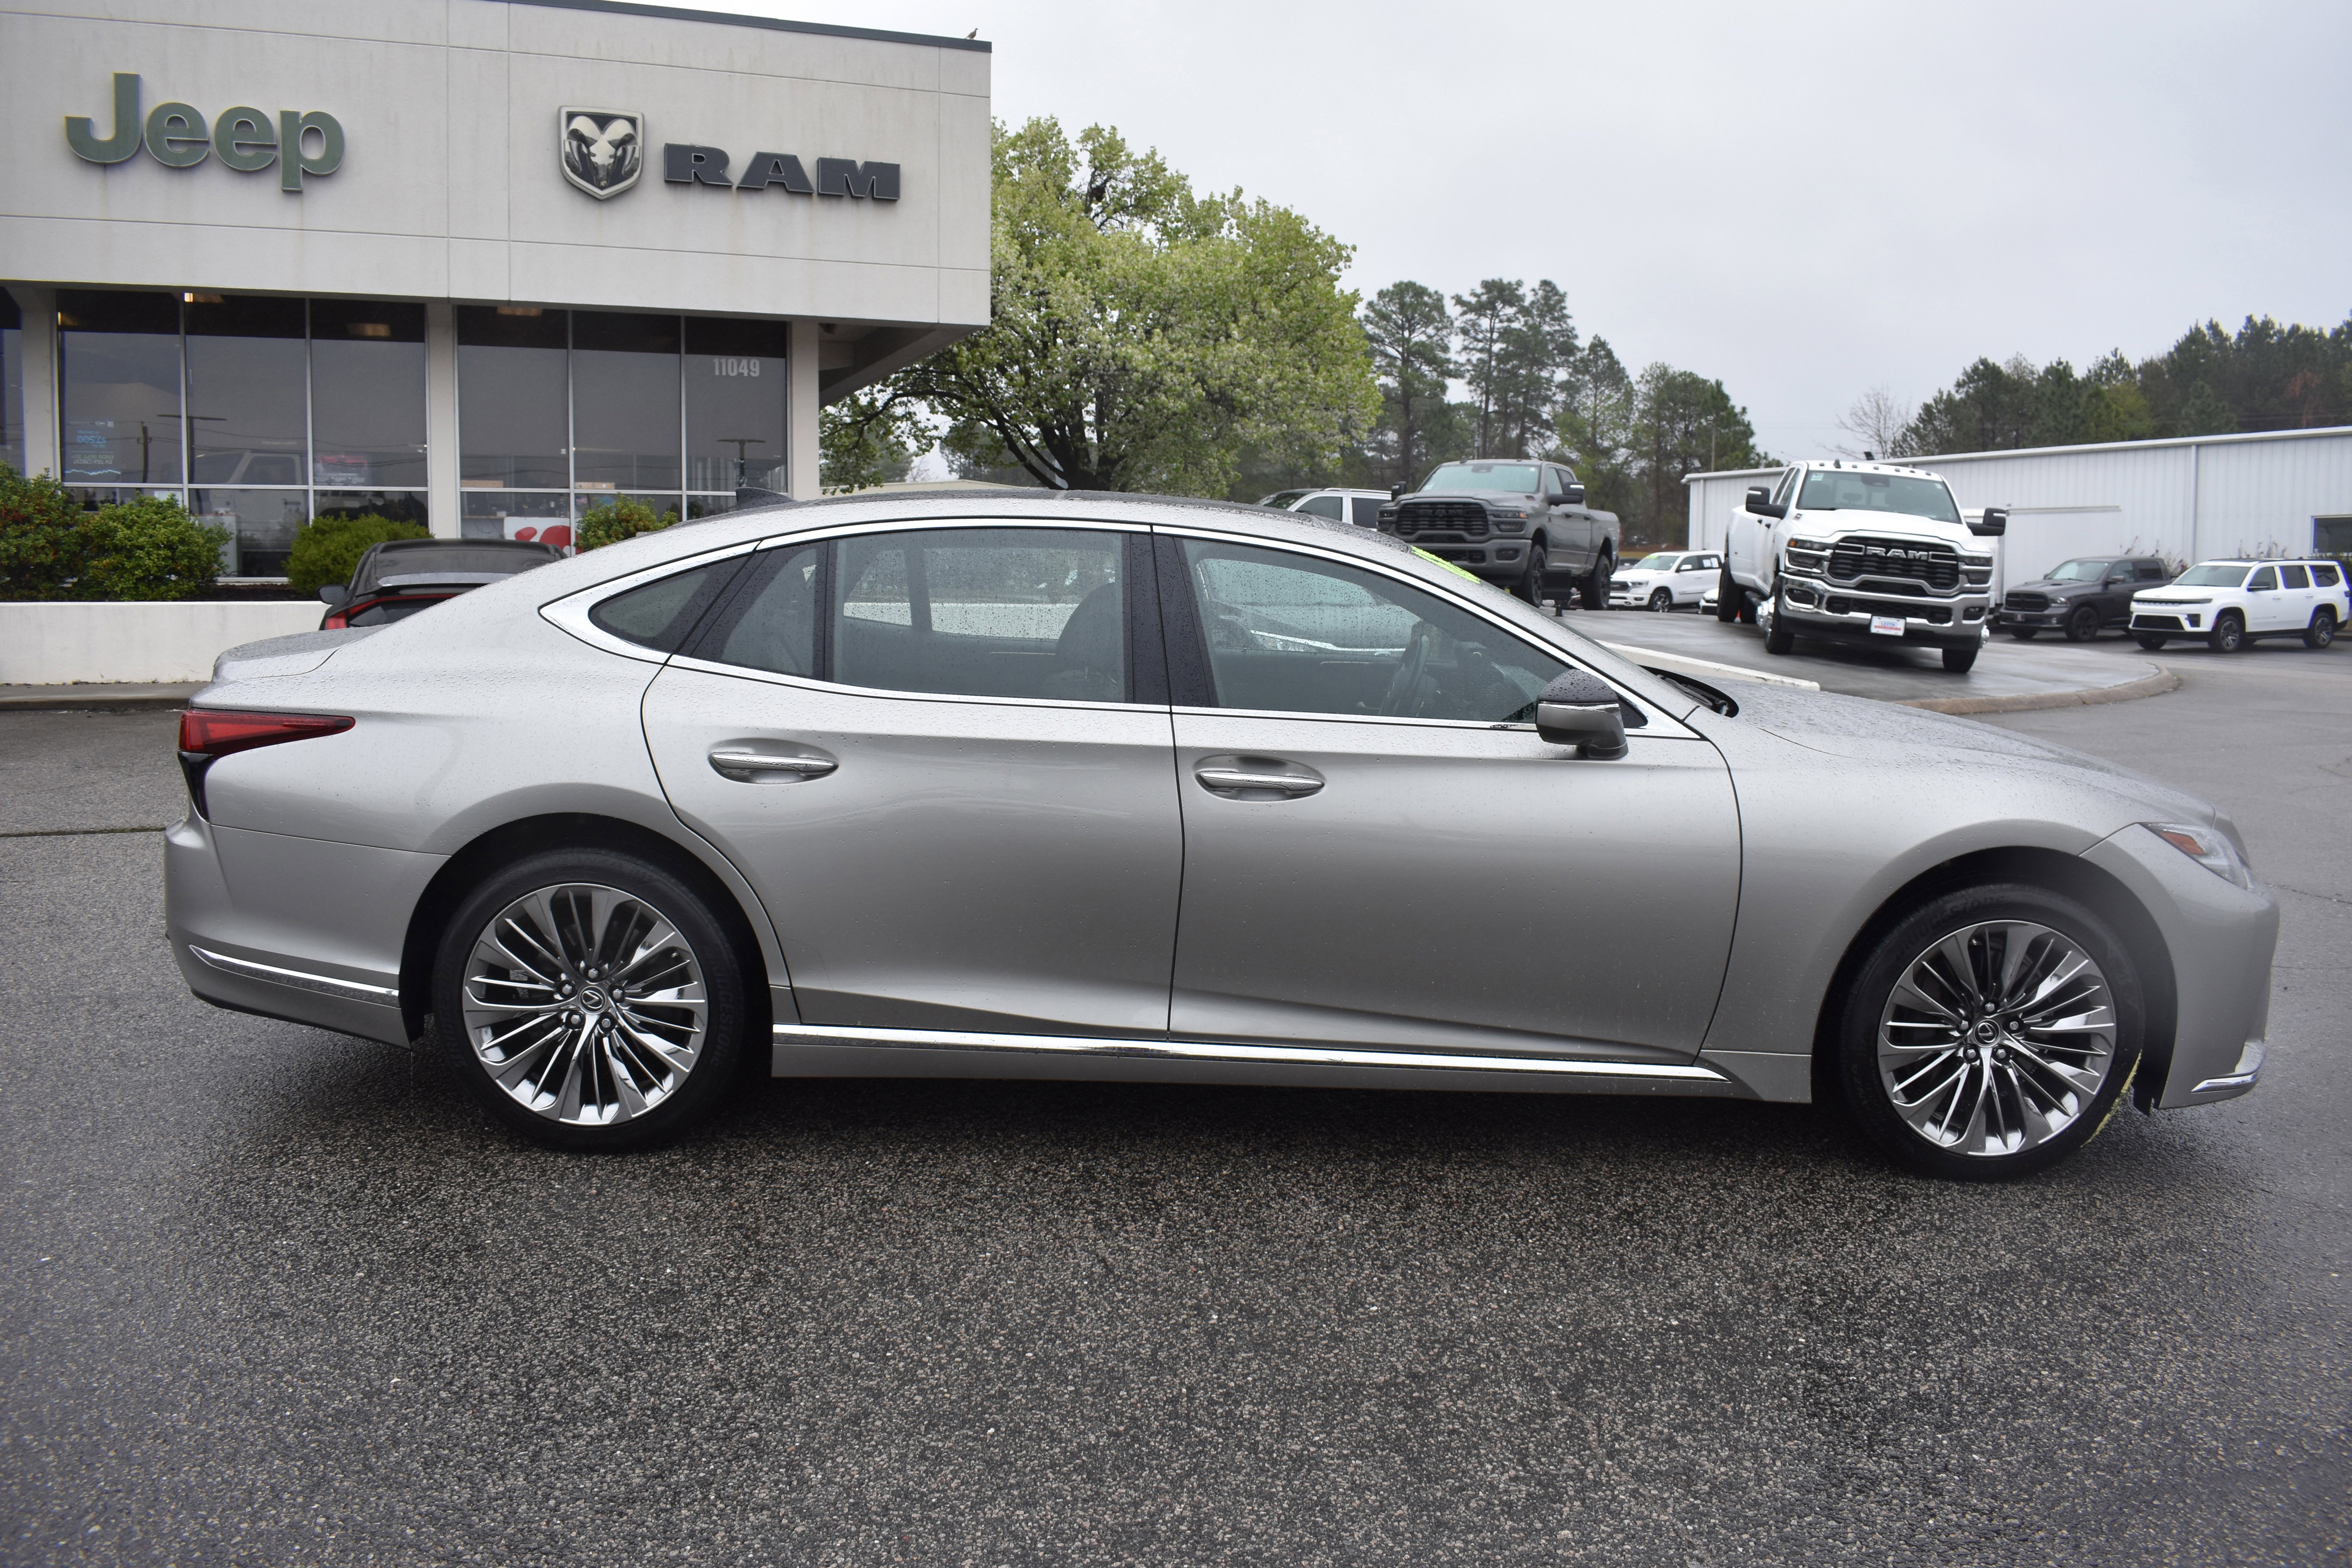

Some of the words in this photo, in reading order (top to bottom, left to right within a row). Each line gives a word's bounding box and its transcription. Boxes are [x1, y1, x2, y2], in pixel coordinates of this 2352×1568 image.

[65, 72, 345, 192] Jeep
[664, 143, 900, 200] RAM
[713, 358, 760, 377] 11049
[77, 435, 106, 443] $7,500
[1866, 546, 1928, 560] RAM
